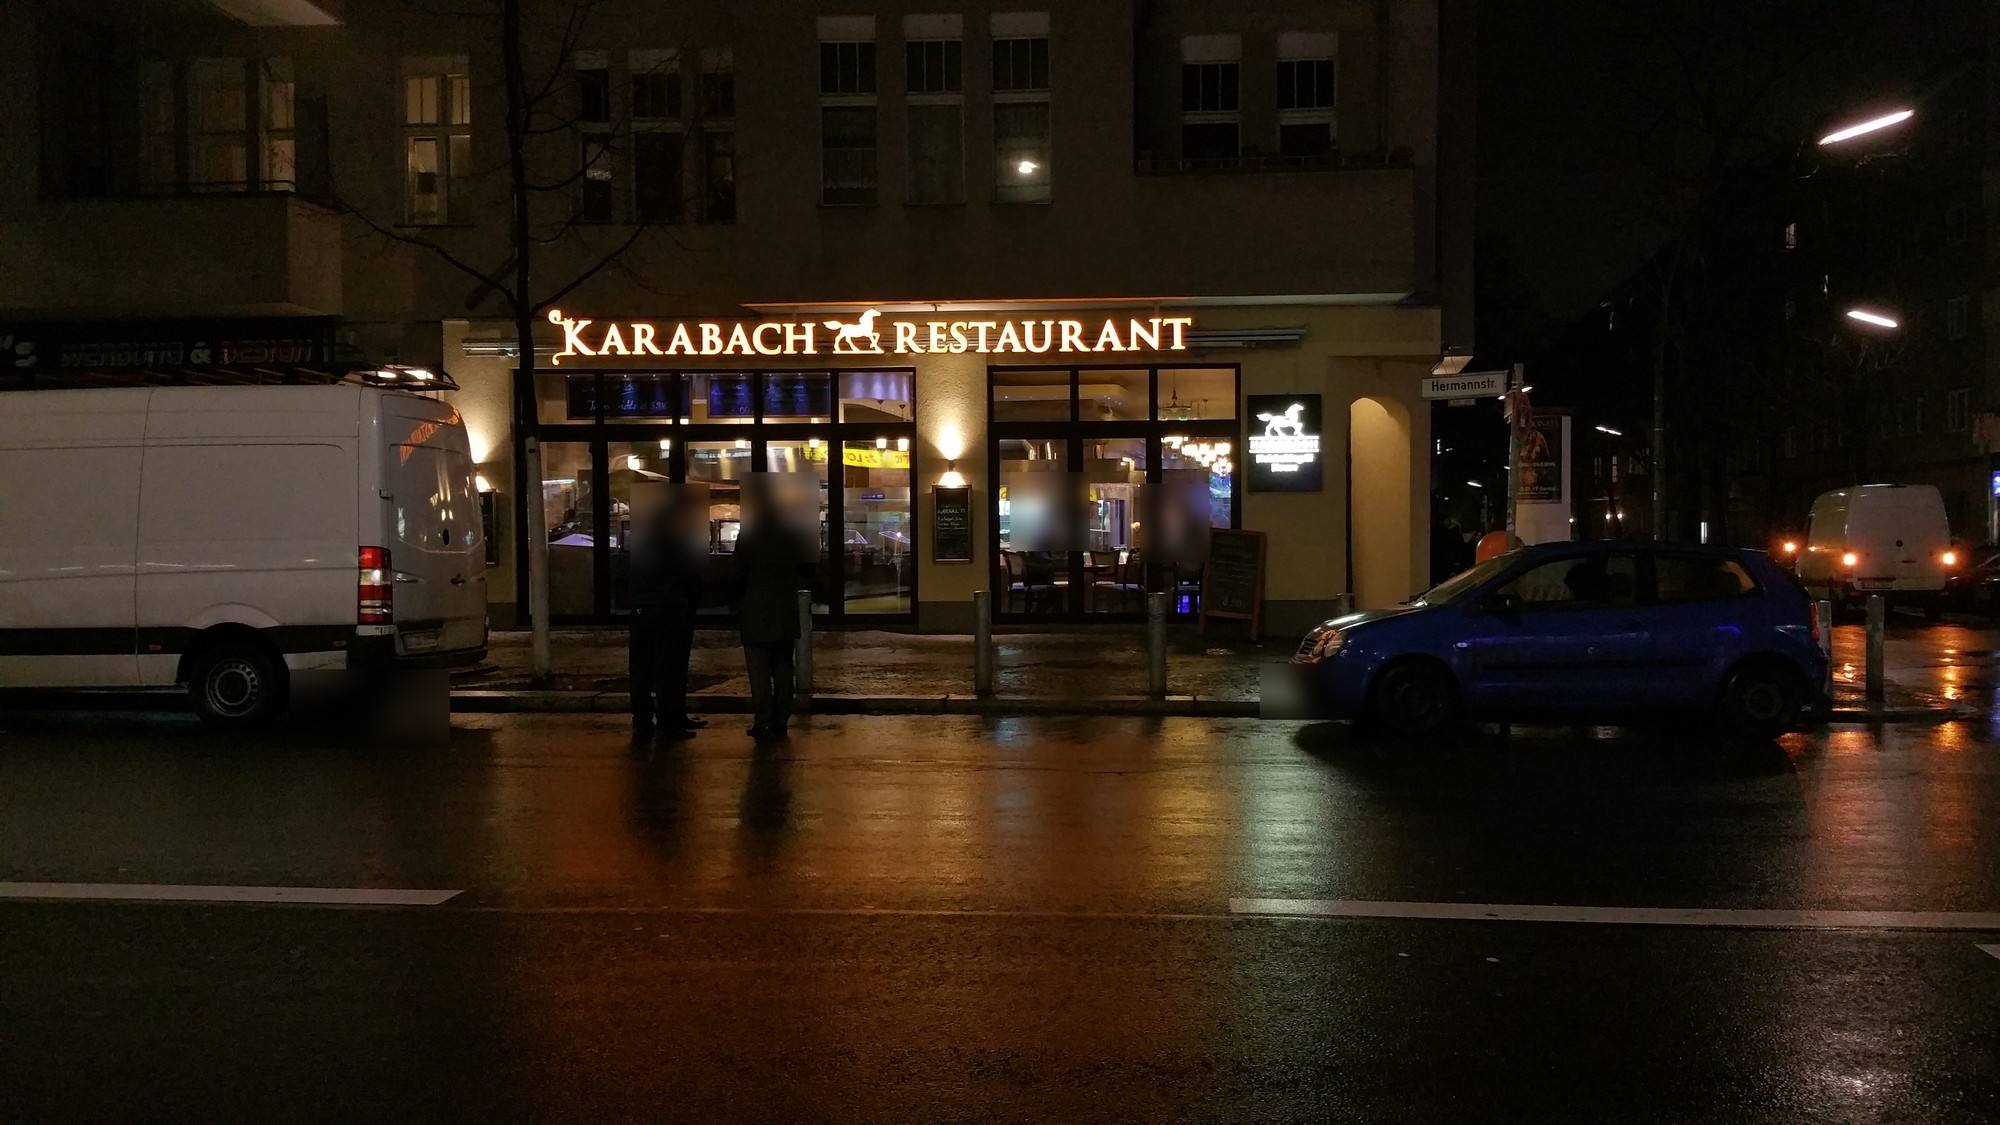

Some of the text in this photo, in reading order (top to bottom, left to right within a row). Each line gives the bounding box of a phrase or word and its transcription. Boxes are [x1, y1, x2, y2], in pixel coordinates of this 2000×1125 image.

[549, 311, 1192, 363] KARABACH RESTAURANT
[1431, 378, 1497, 392] Hermannstr.
